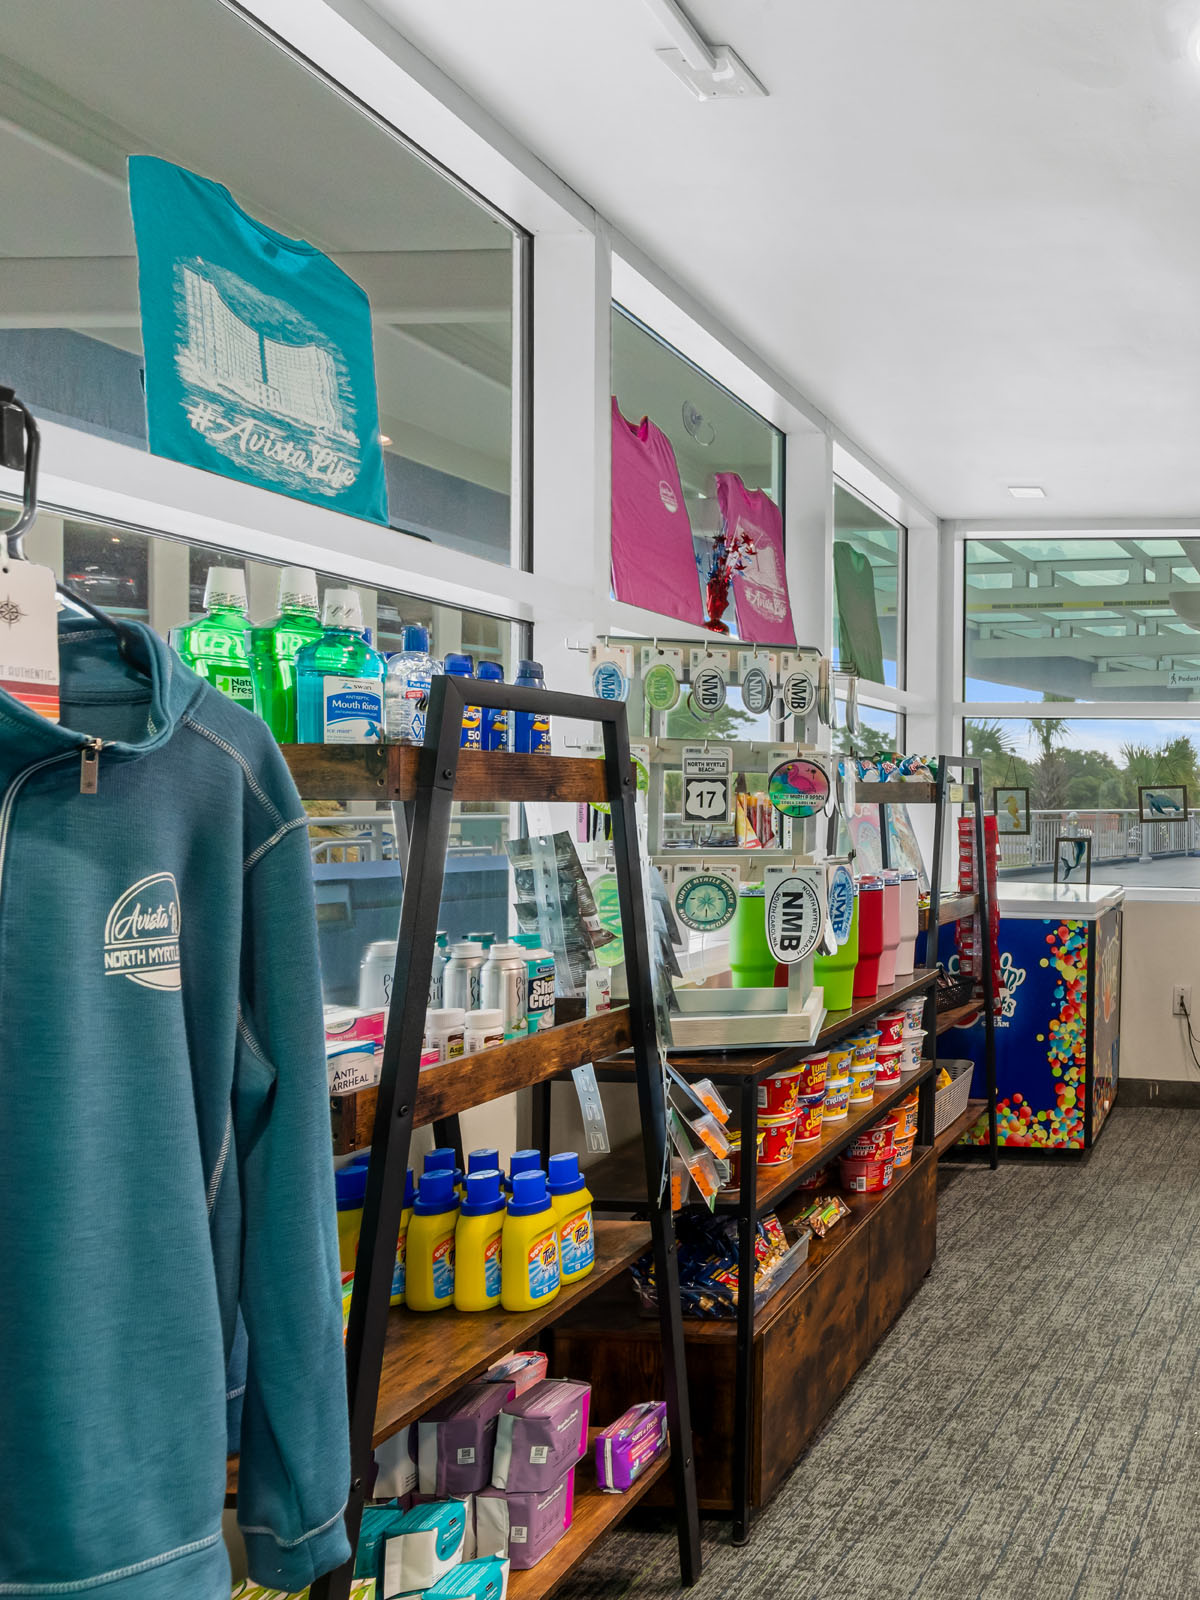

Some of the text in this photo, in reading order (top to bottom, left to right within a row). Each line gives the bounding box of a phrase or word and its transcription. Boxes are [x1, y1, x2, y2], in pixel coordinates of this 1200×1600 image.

[702, 674, 718, 705] NMB
[749, 676, 761, 708] NMB
[791, 678, 807, 709] NMB
[332, 700, 379, 710] Mouth Rinse
[468, 731, 480, 740] 50
[697, 791, 717, 808] 17
[693, 877, 721, 885] MYRTLE
[721, 883, 735, 904] BEACH
[802, 886, 815, 907] NORTH
[679, 908, 733, 930] SOUTH CAROLINA
[833, 883, 846, 933] NMB
[115, 903, 168, 939] Avista
[771, 892, 781, 948] SOUTH CAROLINA
[780, 892, 803, 951] NMB
[797, 934, 815, 956] BEACH
[104, 949, 146, 968] NORTH
[333, 1067, 358, 1081] ANTI-
[575, 1226, 589, 1243] Tide
[543, 1246, 556, 1265] Tide
